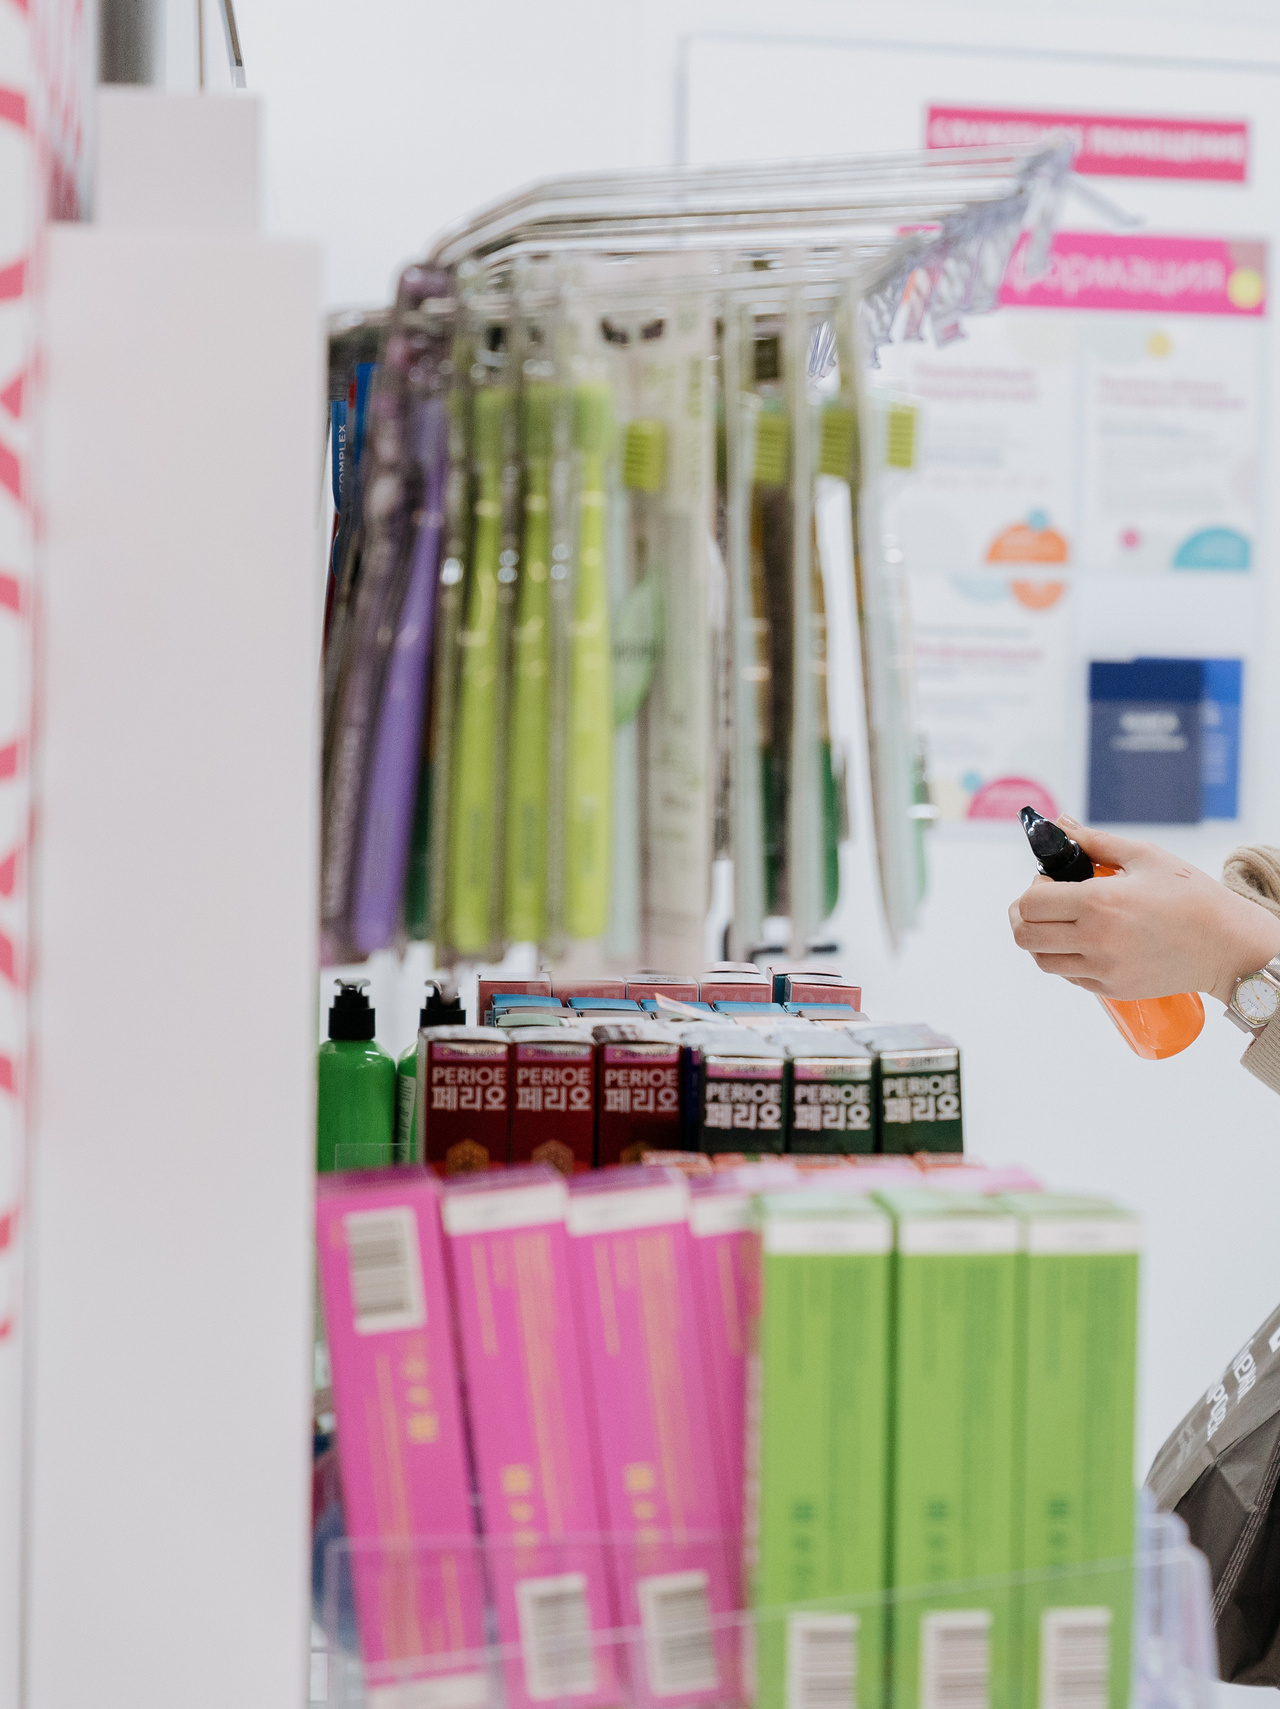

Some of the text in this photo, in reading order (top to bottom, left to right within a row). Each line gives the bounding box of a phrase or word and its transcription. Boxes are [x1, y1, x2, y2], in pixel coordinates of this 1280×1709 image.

[1006, 246, 1226, 299] формация
[432, 1067, 505, 1086] PERIOE
[516, 1067, 591, 1086] PERIOE
[605, 1068, 679, 1087] PERIOE
[882, 1074, 959, 1098] PERIOE
[431, 1086, 506, 1112] 페리오
[516, 1086, 591, 1112] 페리오
[604, 1087, 679, 1113] 페리오
[705, 1082, 782, 1103] PERIOE
[794, 1084, 870, 1104] PERIOE
[704, 1103, 782, 1130] 페리오
[793, 1104, 870, 1131] 페리오
[883, 1094, 961, 1123] 페리오
